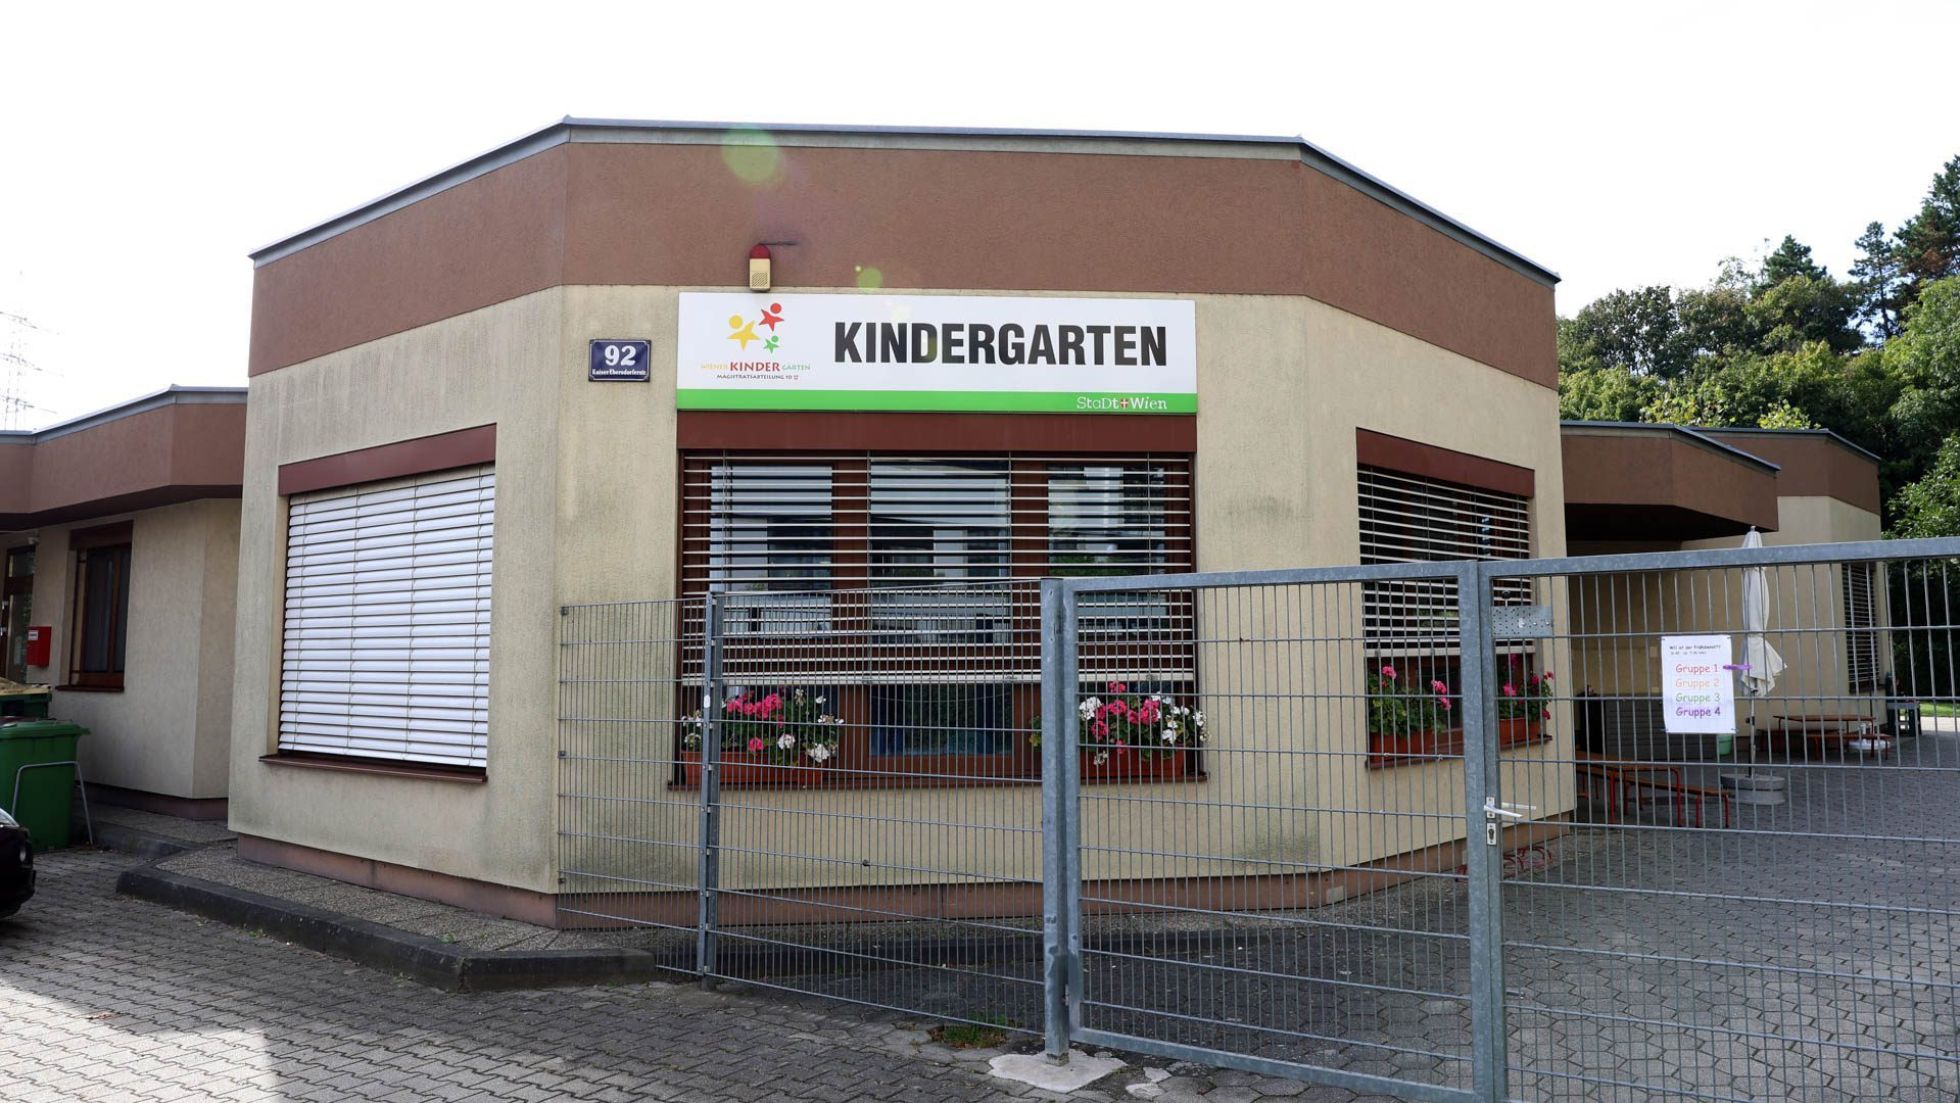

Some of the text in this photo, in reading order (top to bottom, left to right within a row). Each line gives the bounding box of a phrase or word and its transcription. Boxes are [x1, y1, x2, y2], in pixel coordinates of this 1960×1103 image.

[834, 321, 1167, 366] KINDERGARTEN
[604, 344, 637, 366] 92
[730, 362, 780, 372] KINDER
[1130, 396, 1168, 410] Wien
[1675, 664, 1718, 675] Gruppe 1
[1675, 679, 1720, 690] Gruppe 2
[1675, 693, 1721, 704] Gruppe 3
[1675, 707, 1721, 718] Gruppe 4
